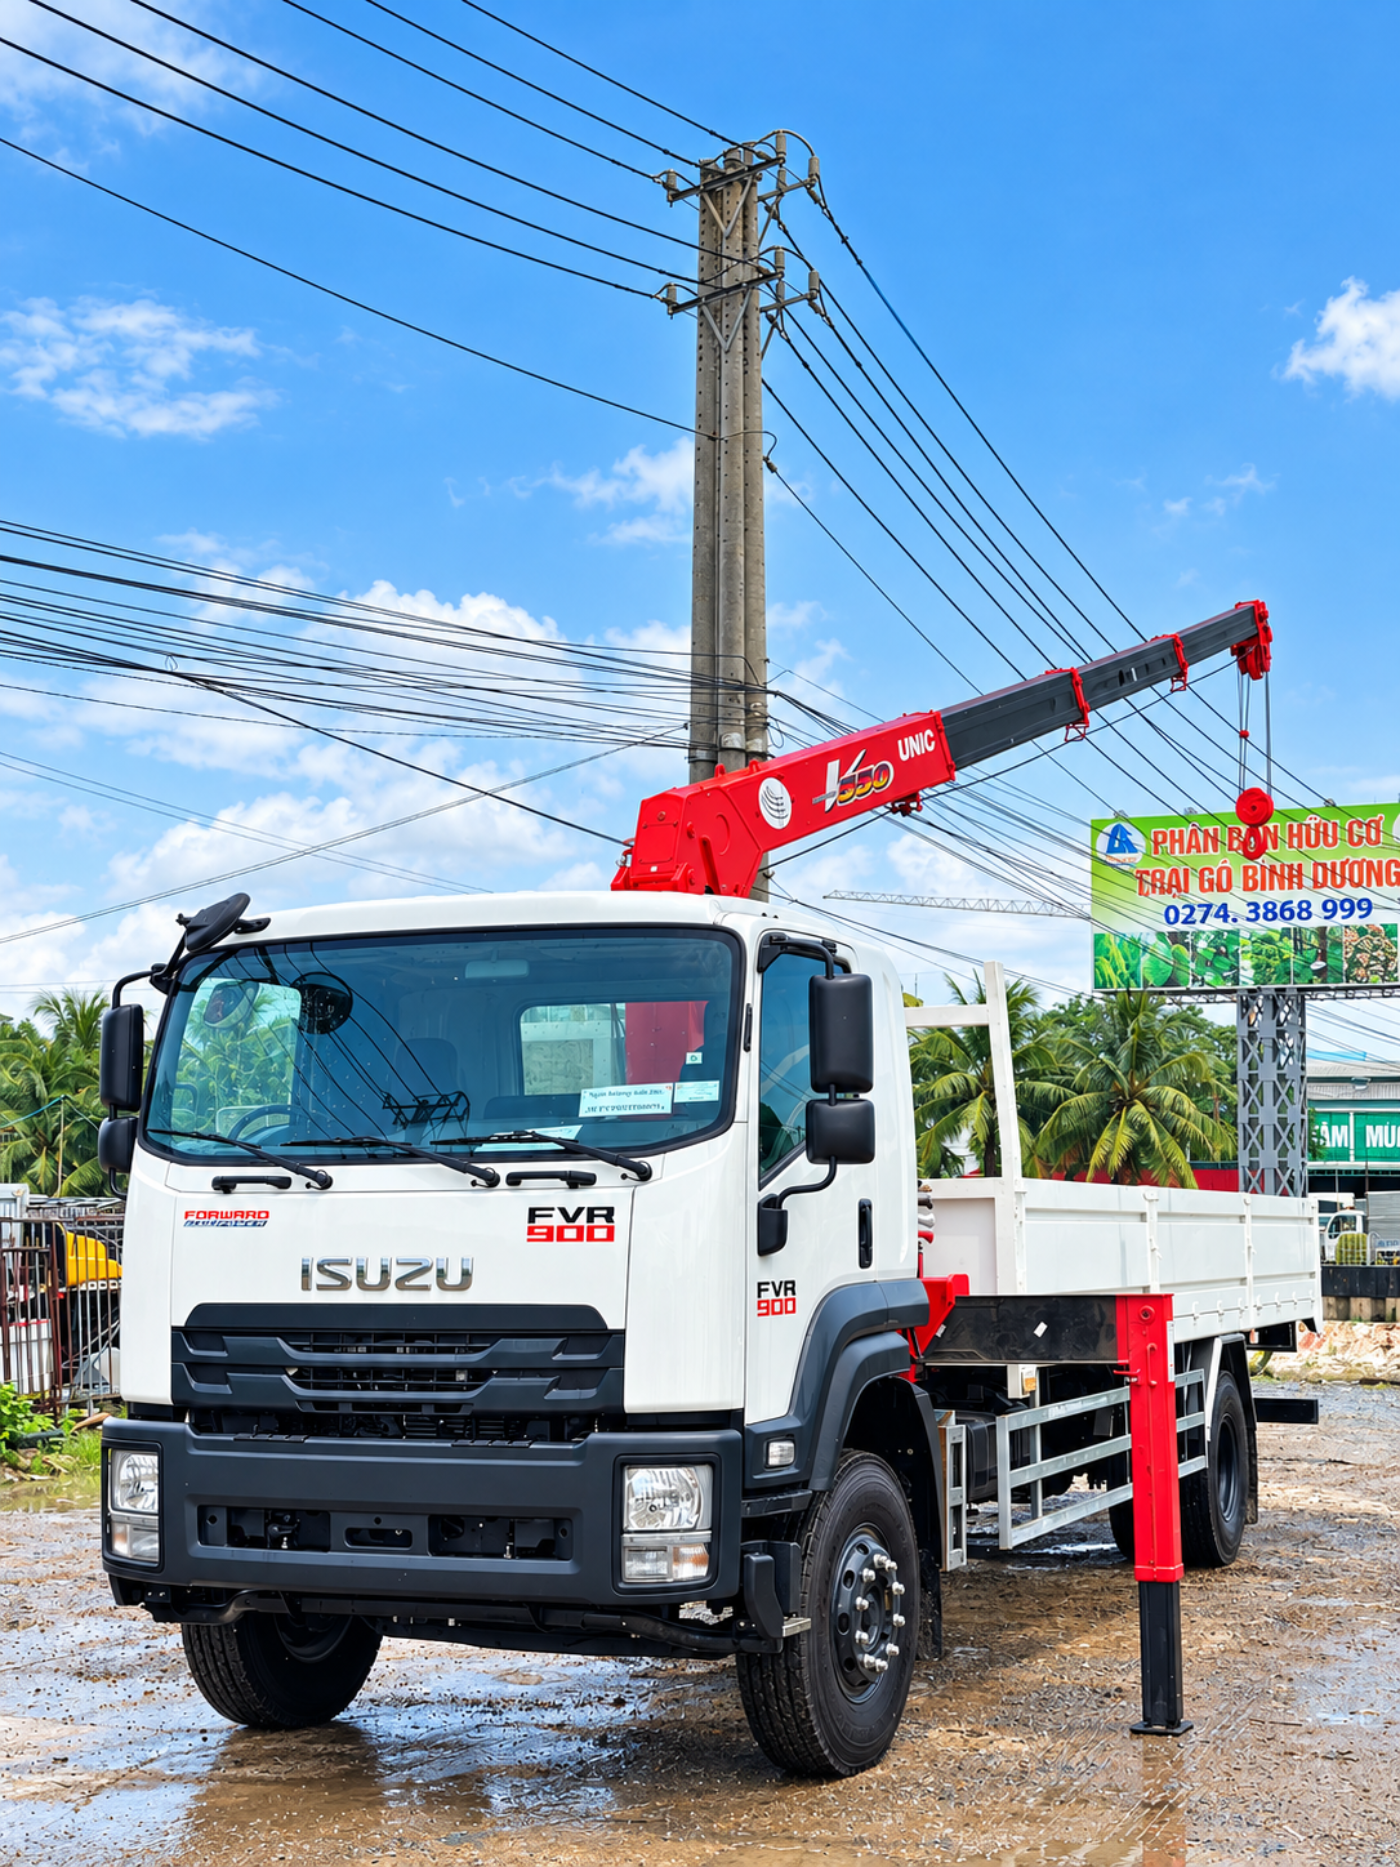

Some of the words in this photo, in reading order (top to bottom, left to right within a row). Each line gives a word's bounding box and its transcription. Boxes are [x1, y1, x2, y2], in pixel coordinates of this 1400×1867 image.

[897, 729, 936, 762] UNIC
[1227, 824, 1279, 852] BN
[1347, 813, 1385, 848] CƠ
[1312, 857, 1400, 889] DƯƠNG
[1163, 902, 1239, 926] 0274.
[1245, 899, 1313, 923] 3868
[1321, 896, 1374, 921] 999
[184, 1209, 270, 1220] FORWARD
[527, 1206, 615, 1224] FVR
[526, 1224, 615, 1242] 900
[301, 1256, 474, 1292] ISUZU
[757, 1279, 796, 1299] FVR
[757, 1297, 796, 1318] 900
